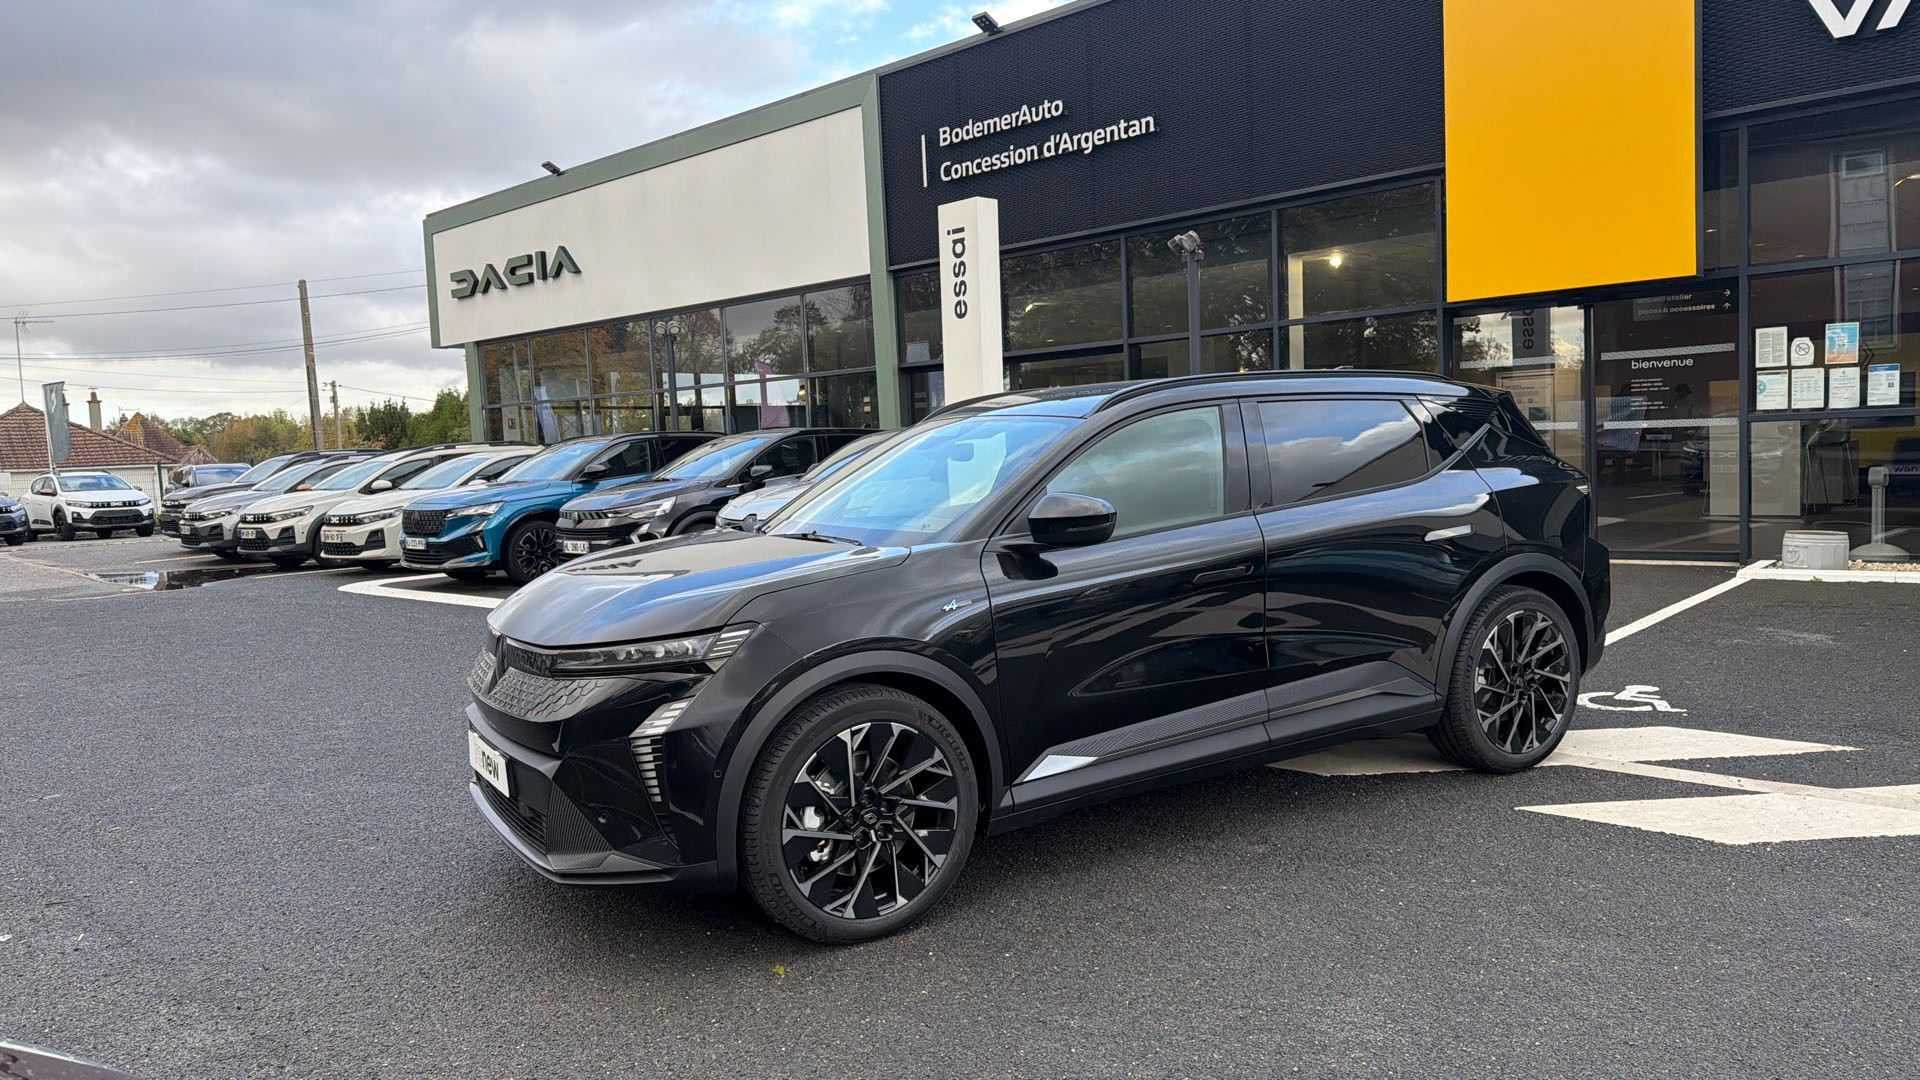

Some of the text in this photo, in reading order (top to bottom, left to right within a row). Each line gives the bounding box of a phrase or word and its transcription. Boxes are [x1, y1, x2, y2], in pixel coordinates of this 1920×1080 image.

[938, 99, 1064, 147] BodemerAuto
[940, 115, 1156, 182] Concession d'Argentan
[450, 245, 582, 299] DACIA
[947, 226, 968, 319] essai
[1667, 293, 1693, 302] atelier
[1669, 303, 1716, 313] accessoires
[1631, 358, 1694, 369] bienvenue
